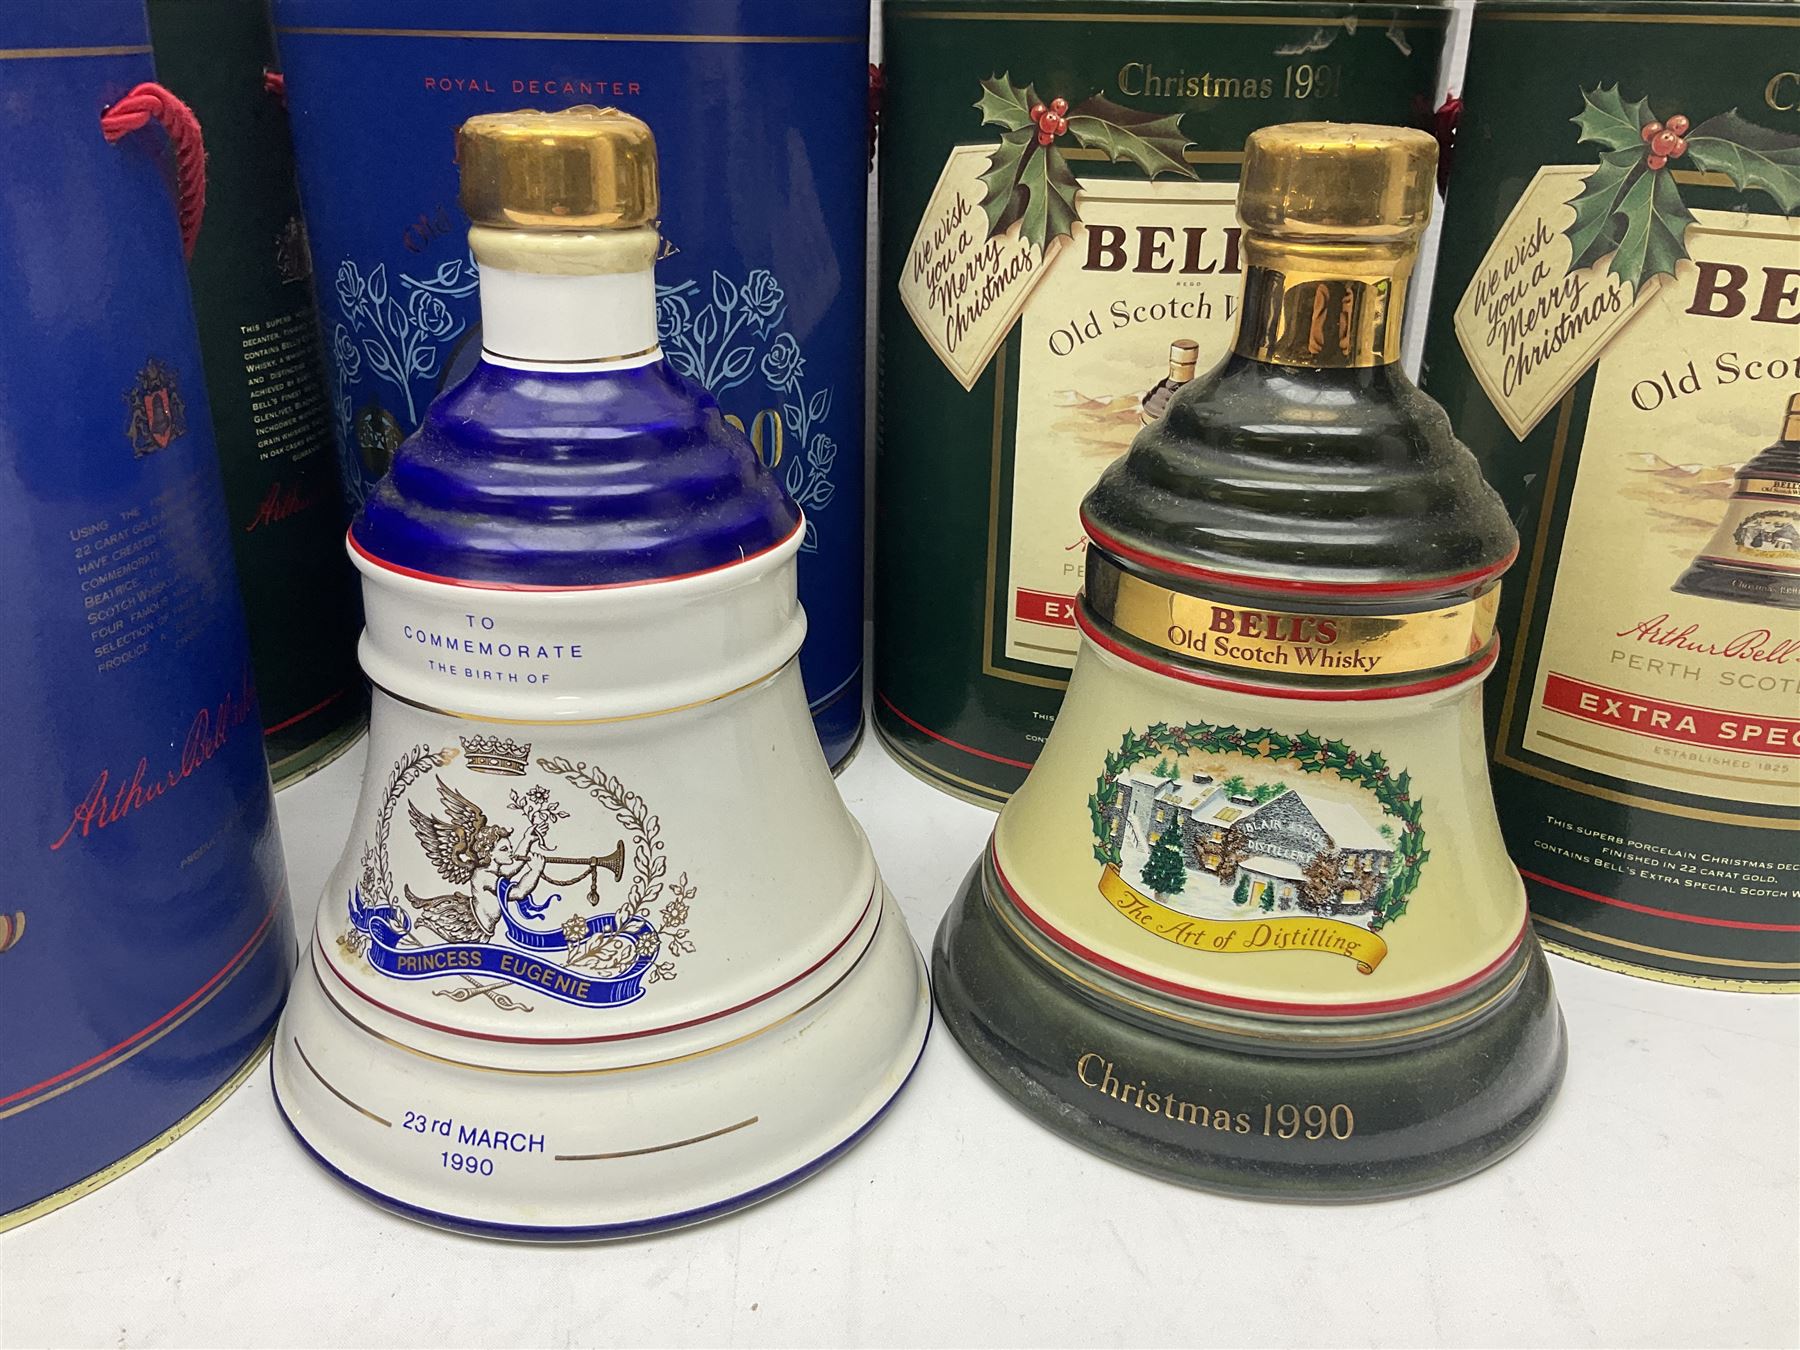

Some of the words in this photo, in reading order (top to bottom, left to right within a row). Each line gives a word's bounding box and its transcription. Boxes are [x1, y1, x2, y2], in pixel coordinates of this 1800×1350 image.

[424, 77, 496, 92] ROYAL
[512, 80, 641, 96] DECANTER
[1118, 62, 1272, 98] Christmas
[934, 192, 972, 249] wish
[926, 249, 956, 309] you
[959, 230, 973, 254] a
[1504, 217, 1554, 281] wish
[937, 240, 1005, 316] Merry
[946, 248, 1032, 353] Christmas
[1049, 310, 1103, 356] Old
[1110, 292, 1212, 329] Scotch
[1487, 280, 1529, 347] you
[1532, 261, 1551, 287] a
[1499, 274, 1589, 355] Merry
[1503, 284, 1621, 397] Christmas
[1631, 360, 1702, 411] Old
[404, 625, 583, 658] COMMEMORATE
[466, 614, 494, 630] TO
[1209, 606, 1337, 645] BELL'S
[1616, 614, 1720, 658] Arthur
[1722, 629, 1792, 664] Bell
[429, 660, 457, 675] THE
[465, 668, 518, 683] BIRTH
[527, 674, 550, 683] OF
[1168, 625, 1206, 652] Old
[1214, 636, 1288, 665] Scotch
[1294, 646, 1381, 672] Whisky
[1610, 650, 1701, 681] PERTH
[1579, 692, 1697, 734] EXTRA
[1653, 746, 1751, 769] ESTABLISHED
[1758, 762, 1789, 774] 1825
[1546, 815, 1573, 831] THIS
[1576, 826, 1624, 845] SUPERB
[1628, 840, 1696, 860] PORCELAIN
[1701, 853, 1774, 870] CHRISTMAS
[1601, 847, 1659, 867] FINISHED
[1663, 861, 1676, 870] IN
[1679, 864, 1697, 874] 22
[1700, 868, 1740, 880] CARAT
[1534, 839, 1590, 864] CONTAINS
[1640, 870, 1680, 885] EXTRA
[1684, 879, 1736, 894] SPECIAL
[1740, 886, 1788, 898] SCOTCH
[1116, 890, 1152, 925] The
[1156, 921, 1205, 946] Art
[1213, 930, 1236, 951] of
[1242, 923, 1361, 957] Distilling
[397, 950, 482, 972] PRINCESS
[500, 954, 591, 999] EUGENIE
[1077, 1052, 1251, 1134] Christmas
[1263, 1103, 1354, 1140] 1990
[441, 1151, 494, 1176] 1990
[458, 1125, 545, 1153] MARCH
